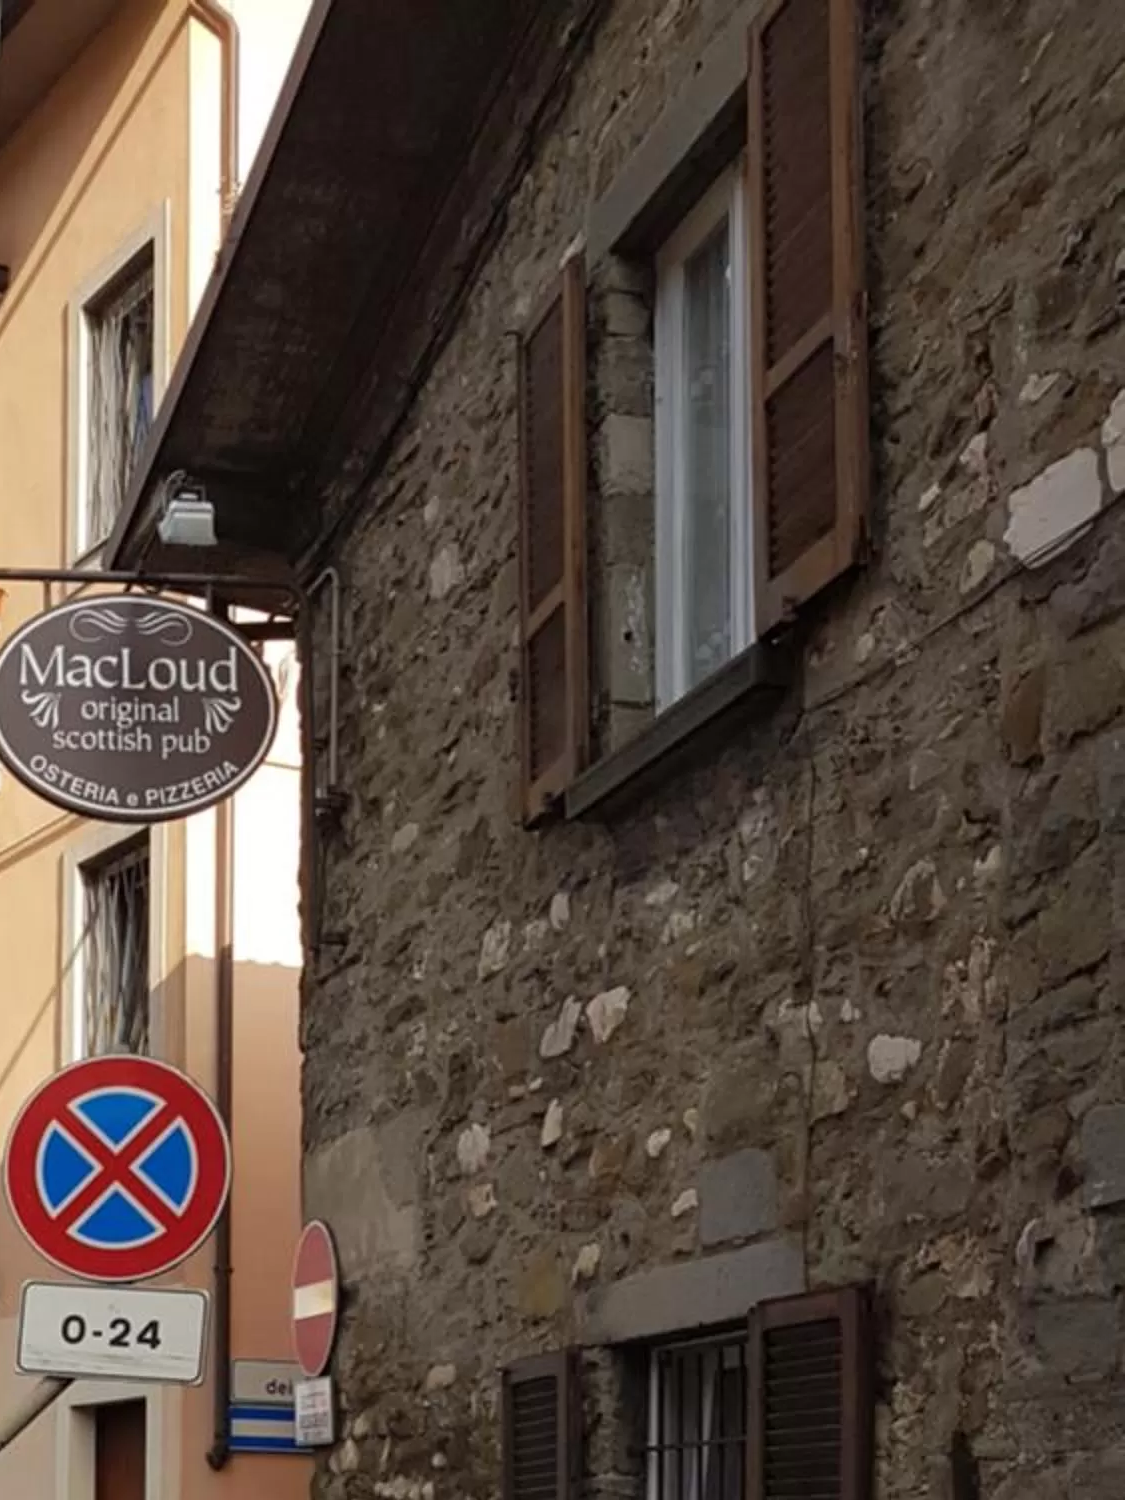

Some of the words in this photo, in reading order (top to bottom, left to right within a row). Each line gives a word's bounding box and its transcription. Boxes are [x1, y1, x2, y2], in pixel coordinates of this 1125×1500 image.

[19, 643, 238, 693] MacLoud
[80, 696, 179, 728] original
[52, 728, 152, 753] scottish
[162, 731, 211, 759] pub
[30, 755, 120, 805] OSTERIA
[127, 793, 139, 807] e
[146, 760, 240, 806] PIZZERIA
[61, 1314, 161, 1349] 0-24
